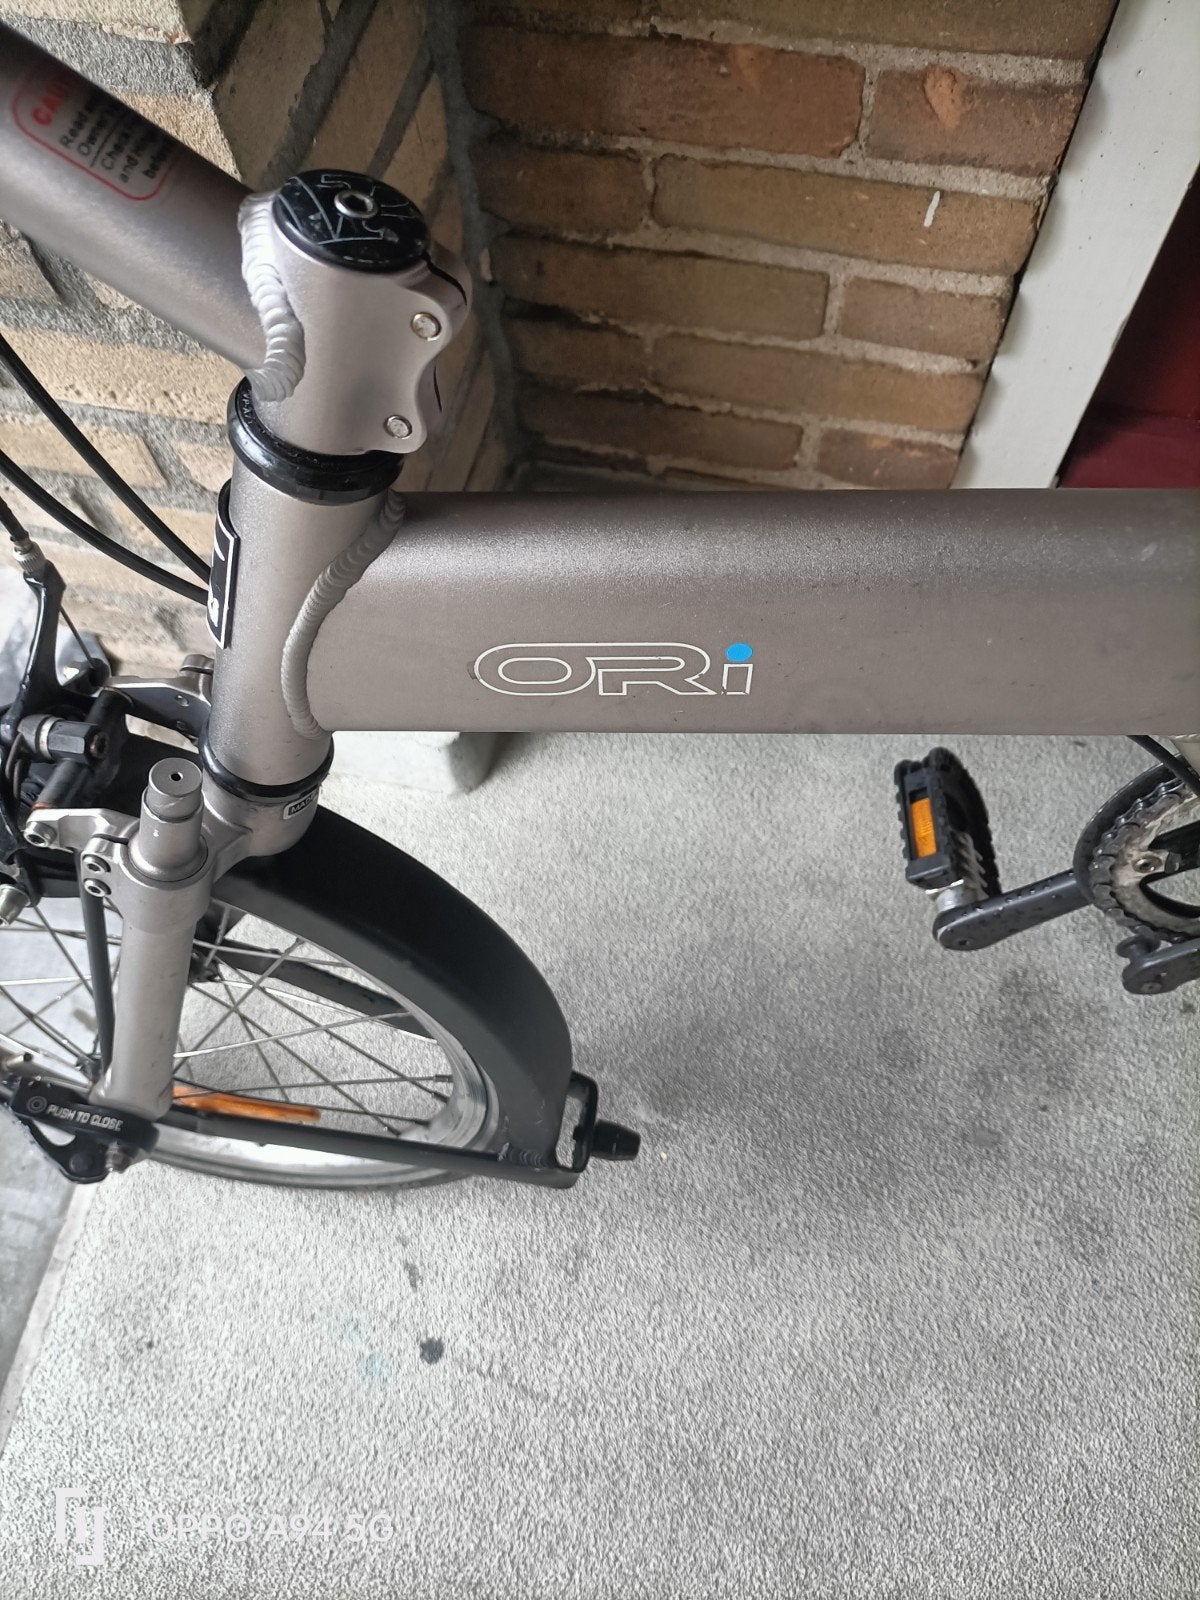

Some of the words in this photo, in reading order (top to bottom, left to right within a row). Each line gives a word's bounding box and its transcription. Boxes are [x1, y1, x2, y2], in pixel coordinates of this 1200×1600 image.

[47, 1104, 75, 1121] PUSH
[76, 1111, 91, 1123] TO
[90, 1114, 124, 1131] CLOSE
